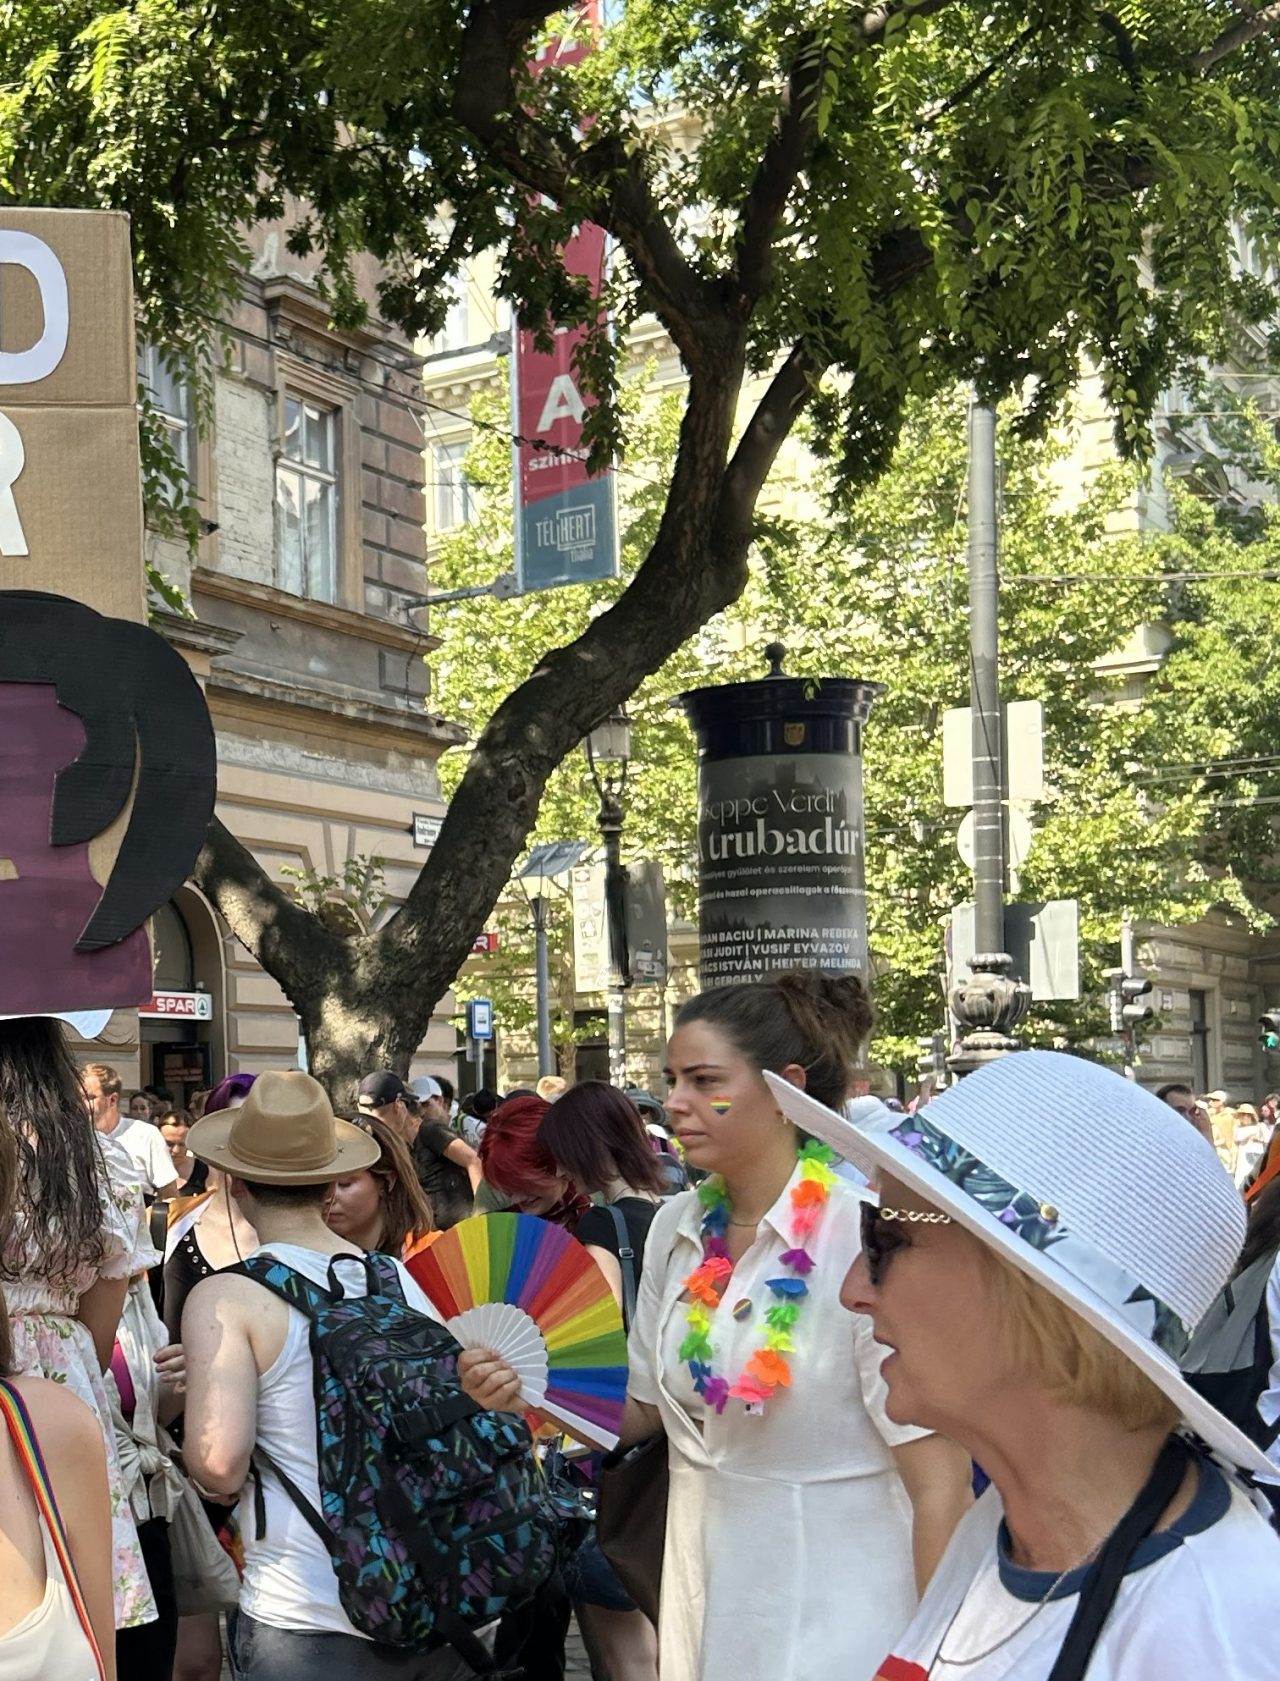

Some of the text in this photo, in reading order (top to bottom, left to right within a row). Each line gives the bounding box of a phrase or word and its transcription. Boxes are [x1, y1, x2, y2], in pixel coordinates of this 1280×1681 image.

[772, 788, 835, 813] Verdi
[709, 816, 859, 861] trubadúr
[764, 928, 820, 940] MARINA
[714, 945, 744, 957] JUDIT
[751, 943, 792, 955] YUSIF
[793, 943, 851, 954] EYVAZOV
[719, 957, 762, 972] ISTVÁN
[156, 998, 195, 1013] SPAR
